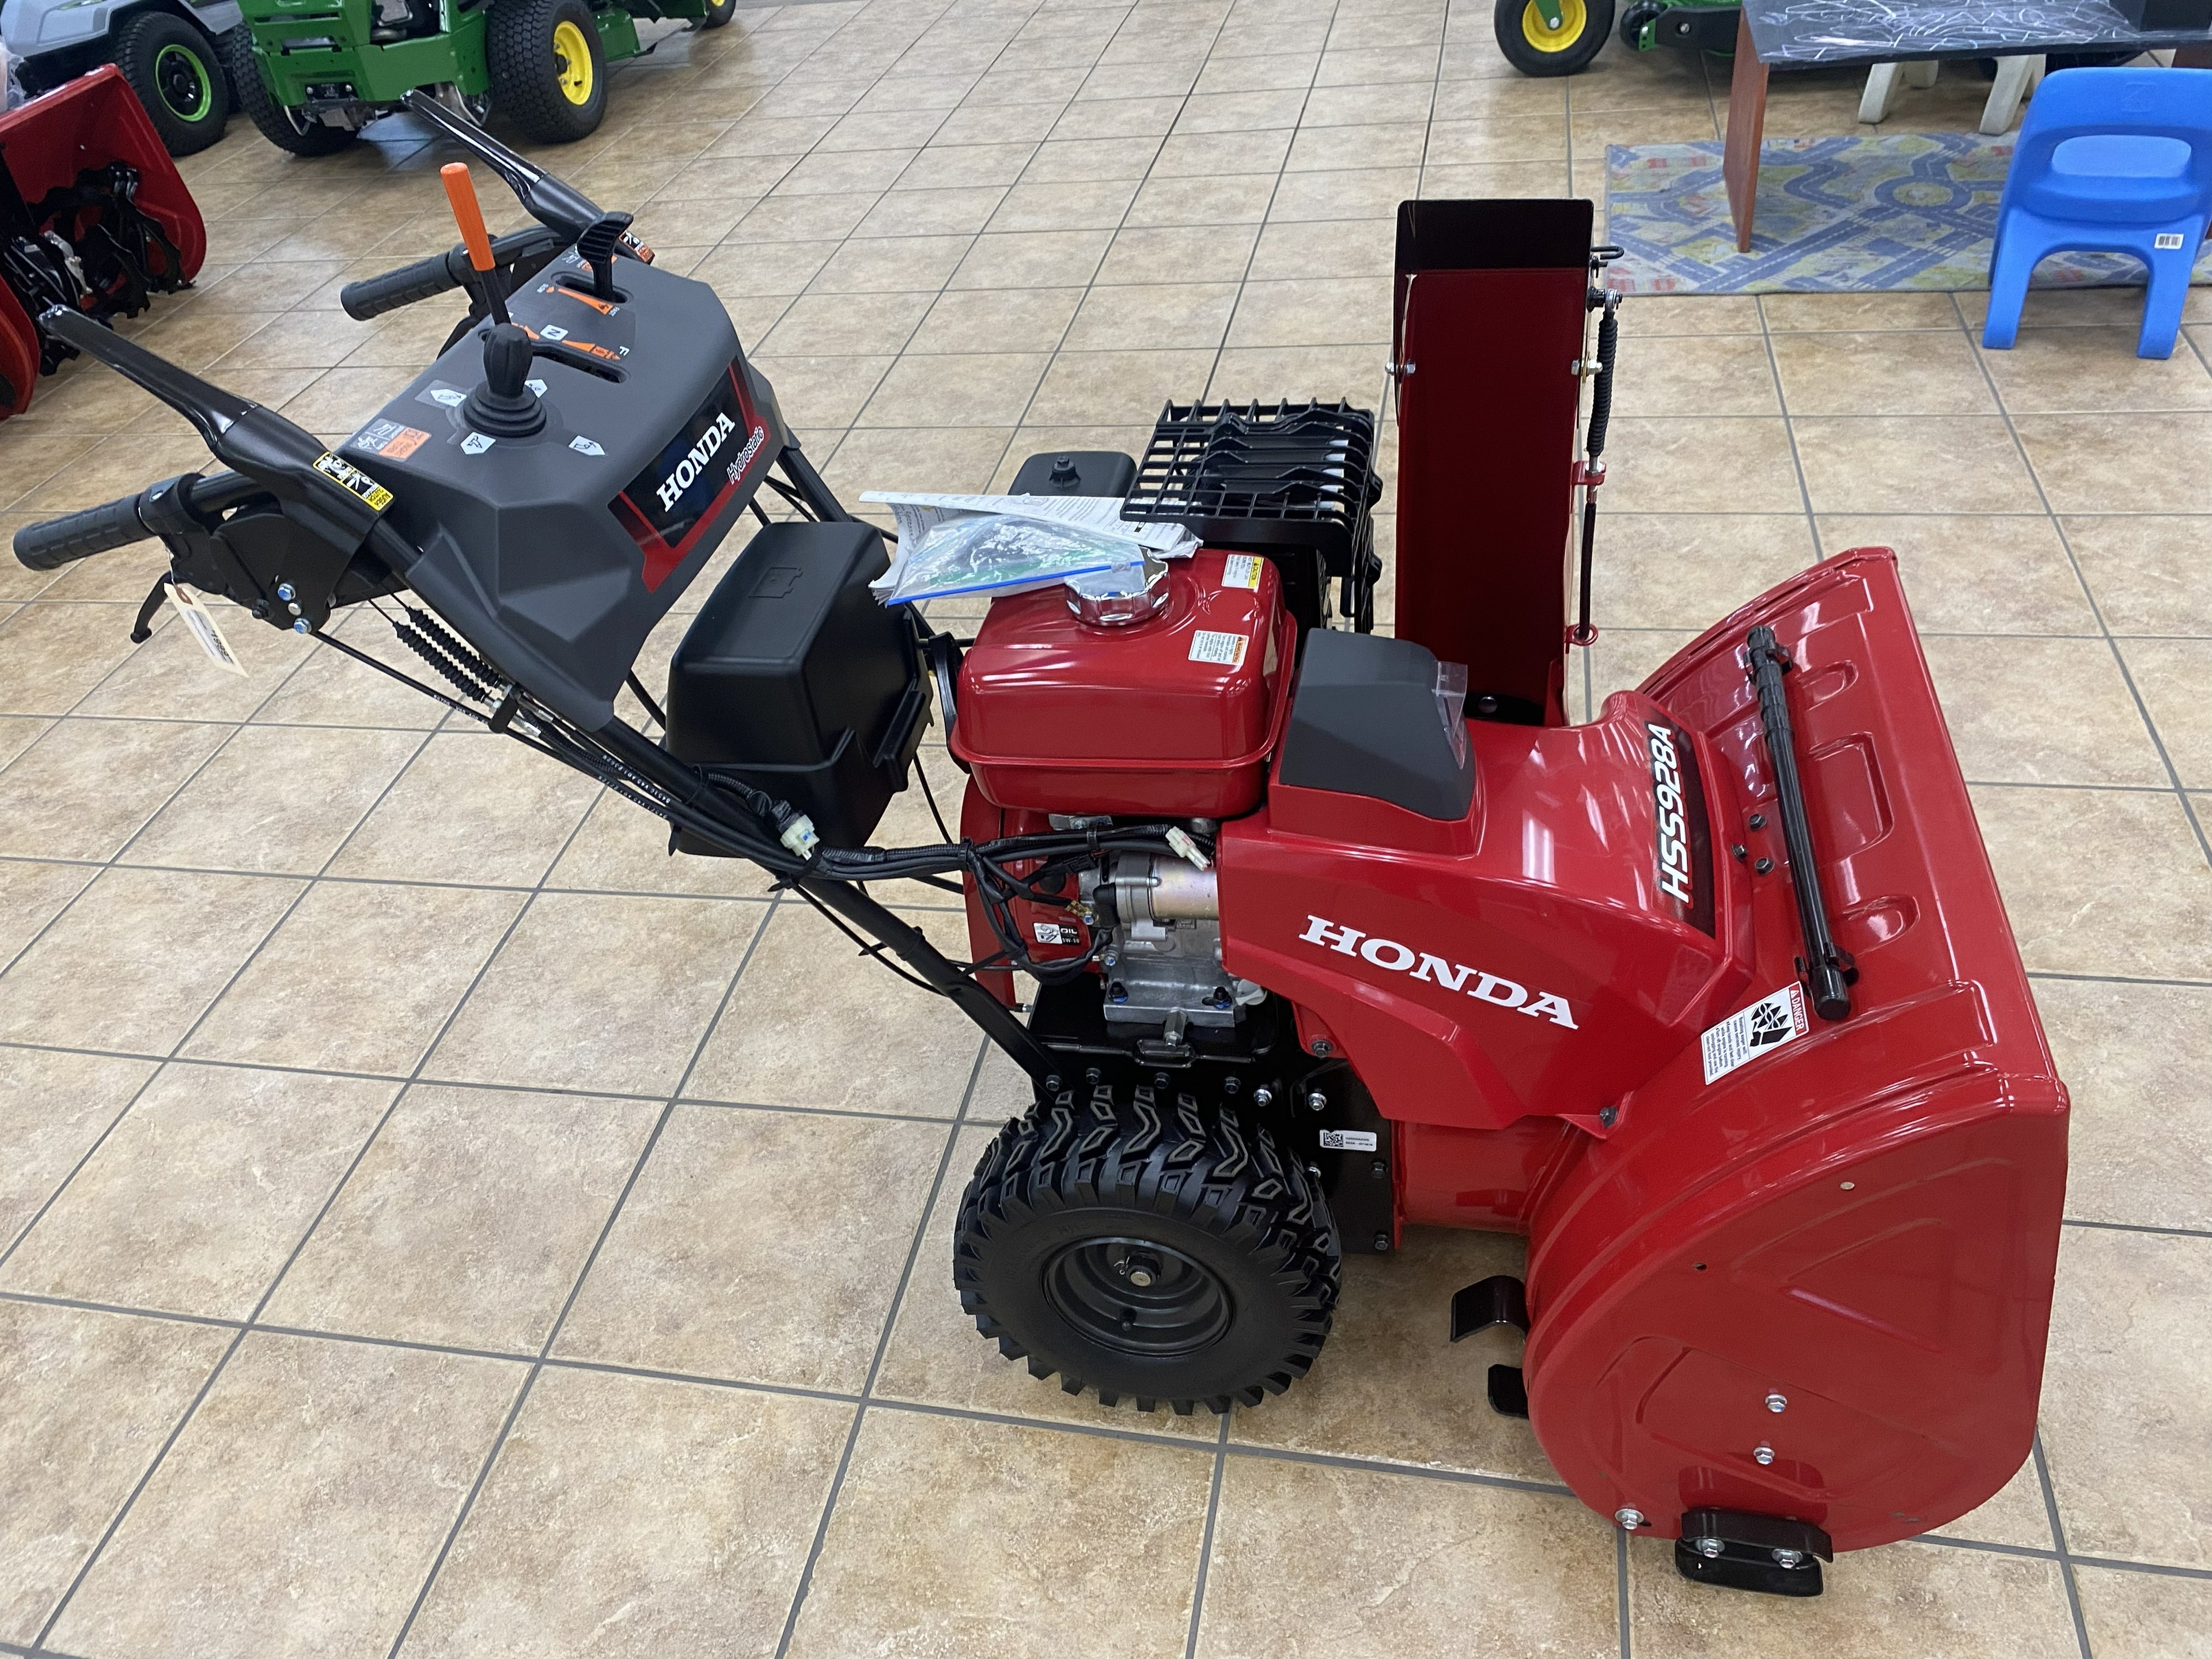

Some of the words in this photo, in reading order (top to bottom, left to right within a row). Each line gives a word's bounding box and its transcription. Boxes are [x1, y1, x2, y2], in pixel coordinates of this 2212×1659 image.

[656, 412, 735, 512] HONDA
[727, 426, 764, 484] Hydrostatic
[1648, 724, 1689, 903] HSS928A
[1298, 914, 1579, 1030] HONDA
[1791, 998, 1805, 1031] DANGER
